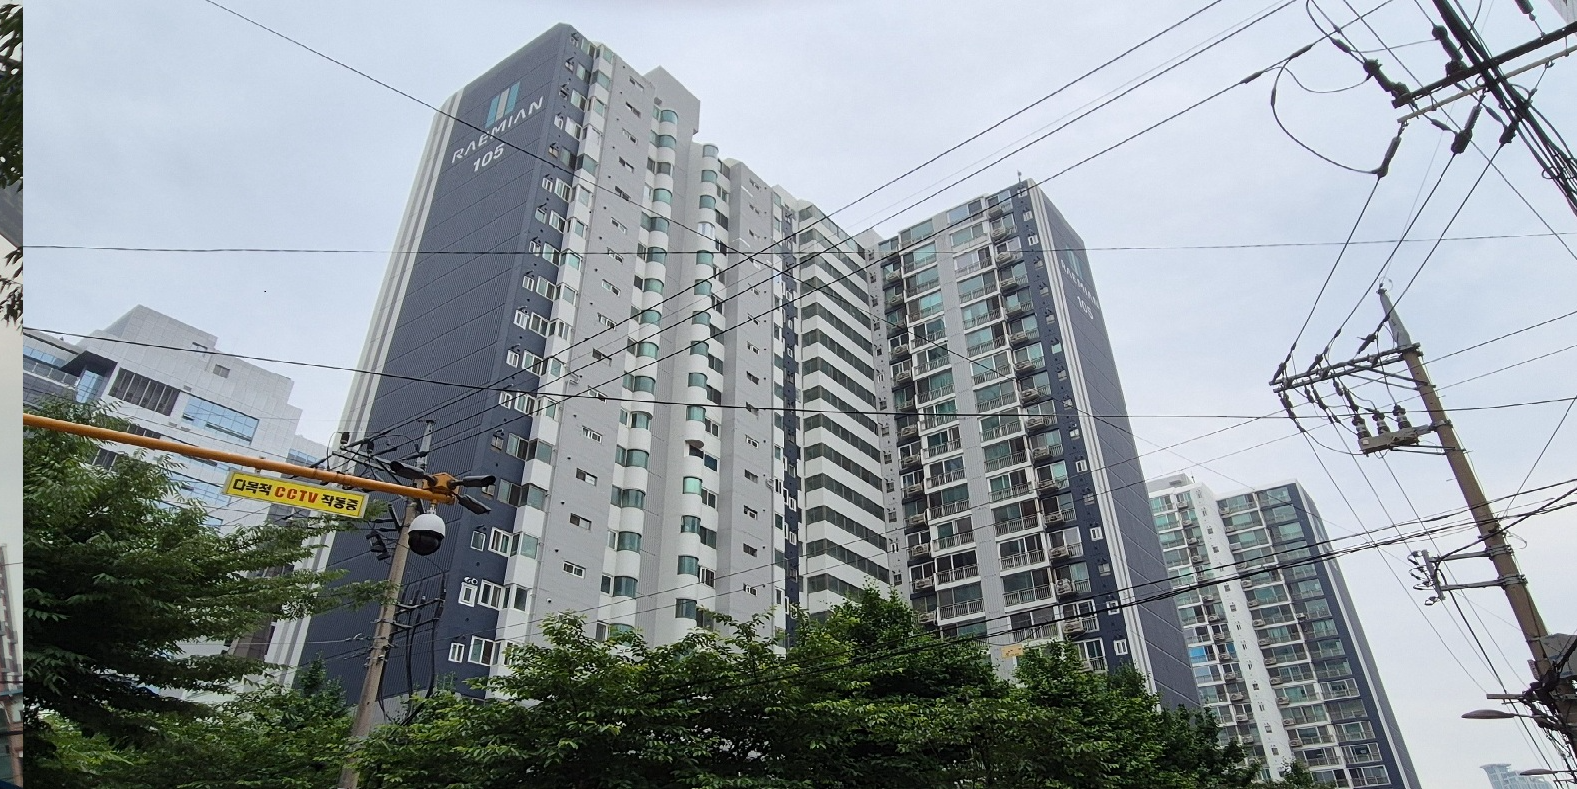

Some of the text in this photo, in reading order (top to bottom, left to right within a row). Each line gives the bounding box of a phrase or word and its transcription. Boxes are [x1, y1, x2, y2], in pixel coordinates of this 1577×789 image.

[451, 95, 544, 164] RAEMIAN
[473, 142, 505, 172] 105
[1076, 295, 1094, 320] 105
[233, 478, 359, 512] 다목적 CCTV 작동중
